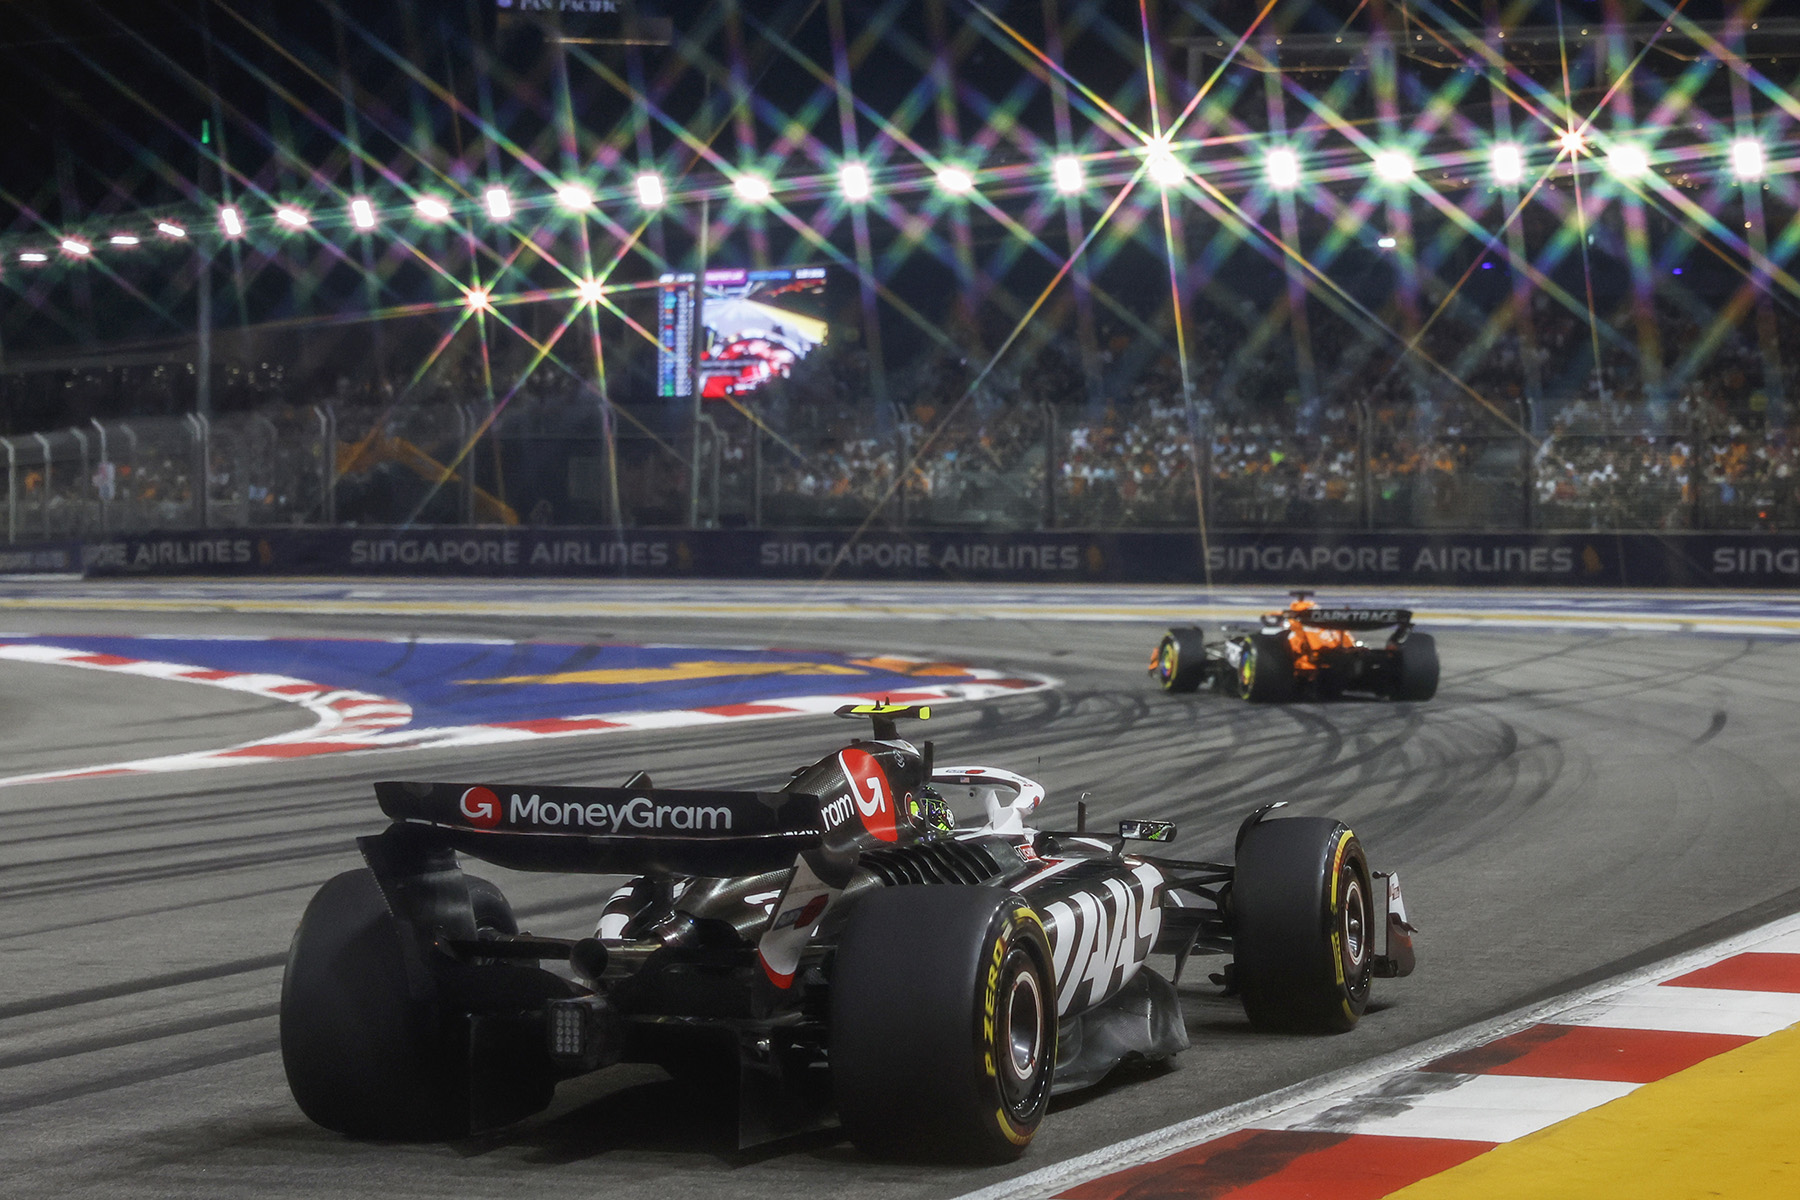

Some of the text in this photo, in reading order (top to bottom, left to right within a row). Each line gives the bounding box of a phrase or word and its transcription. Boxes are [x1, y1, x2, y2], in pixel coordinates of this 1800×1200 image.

[134, 540, 251, 565] AIRLINES
[351, 540, 668, 565] SINGAPORE AIRLINES
[760, 542, 1079, 570] SINGAPORE AIRLINES
[1205, 546, 1573, 572] SINGAPORE AIRLINES
[1712, 547, 1800, 574] SING
[1310, 609, 1398, 623] DARKTRACE
[509, 794, 733, 833] MoneyGram
[983, 936, 1006, 1045] ZERO
